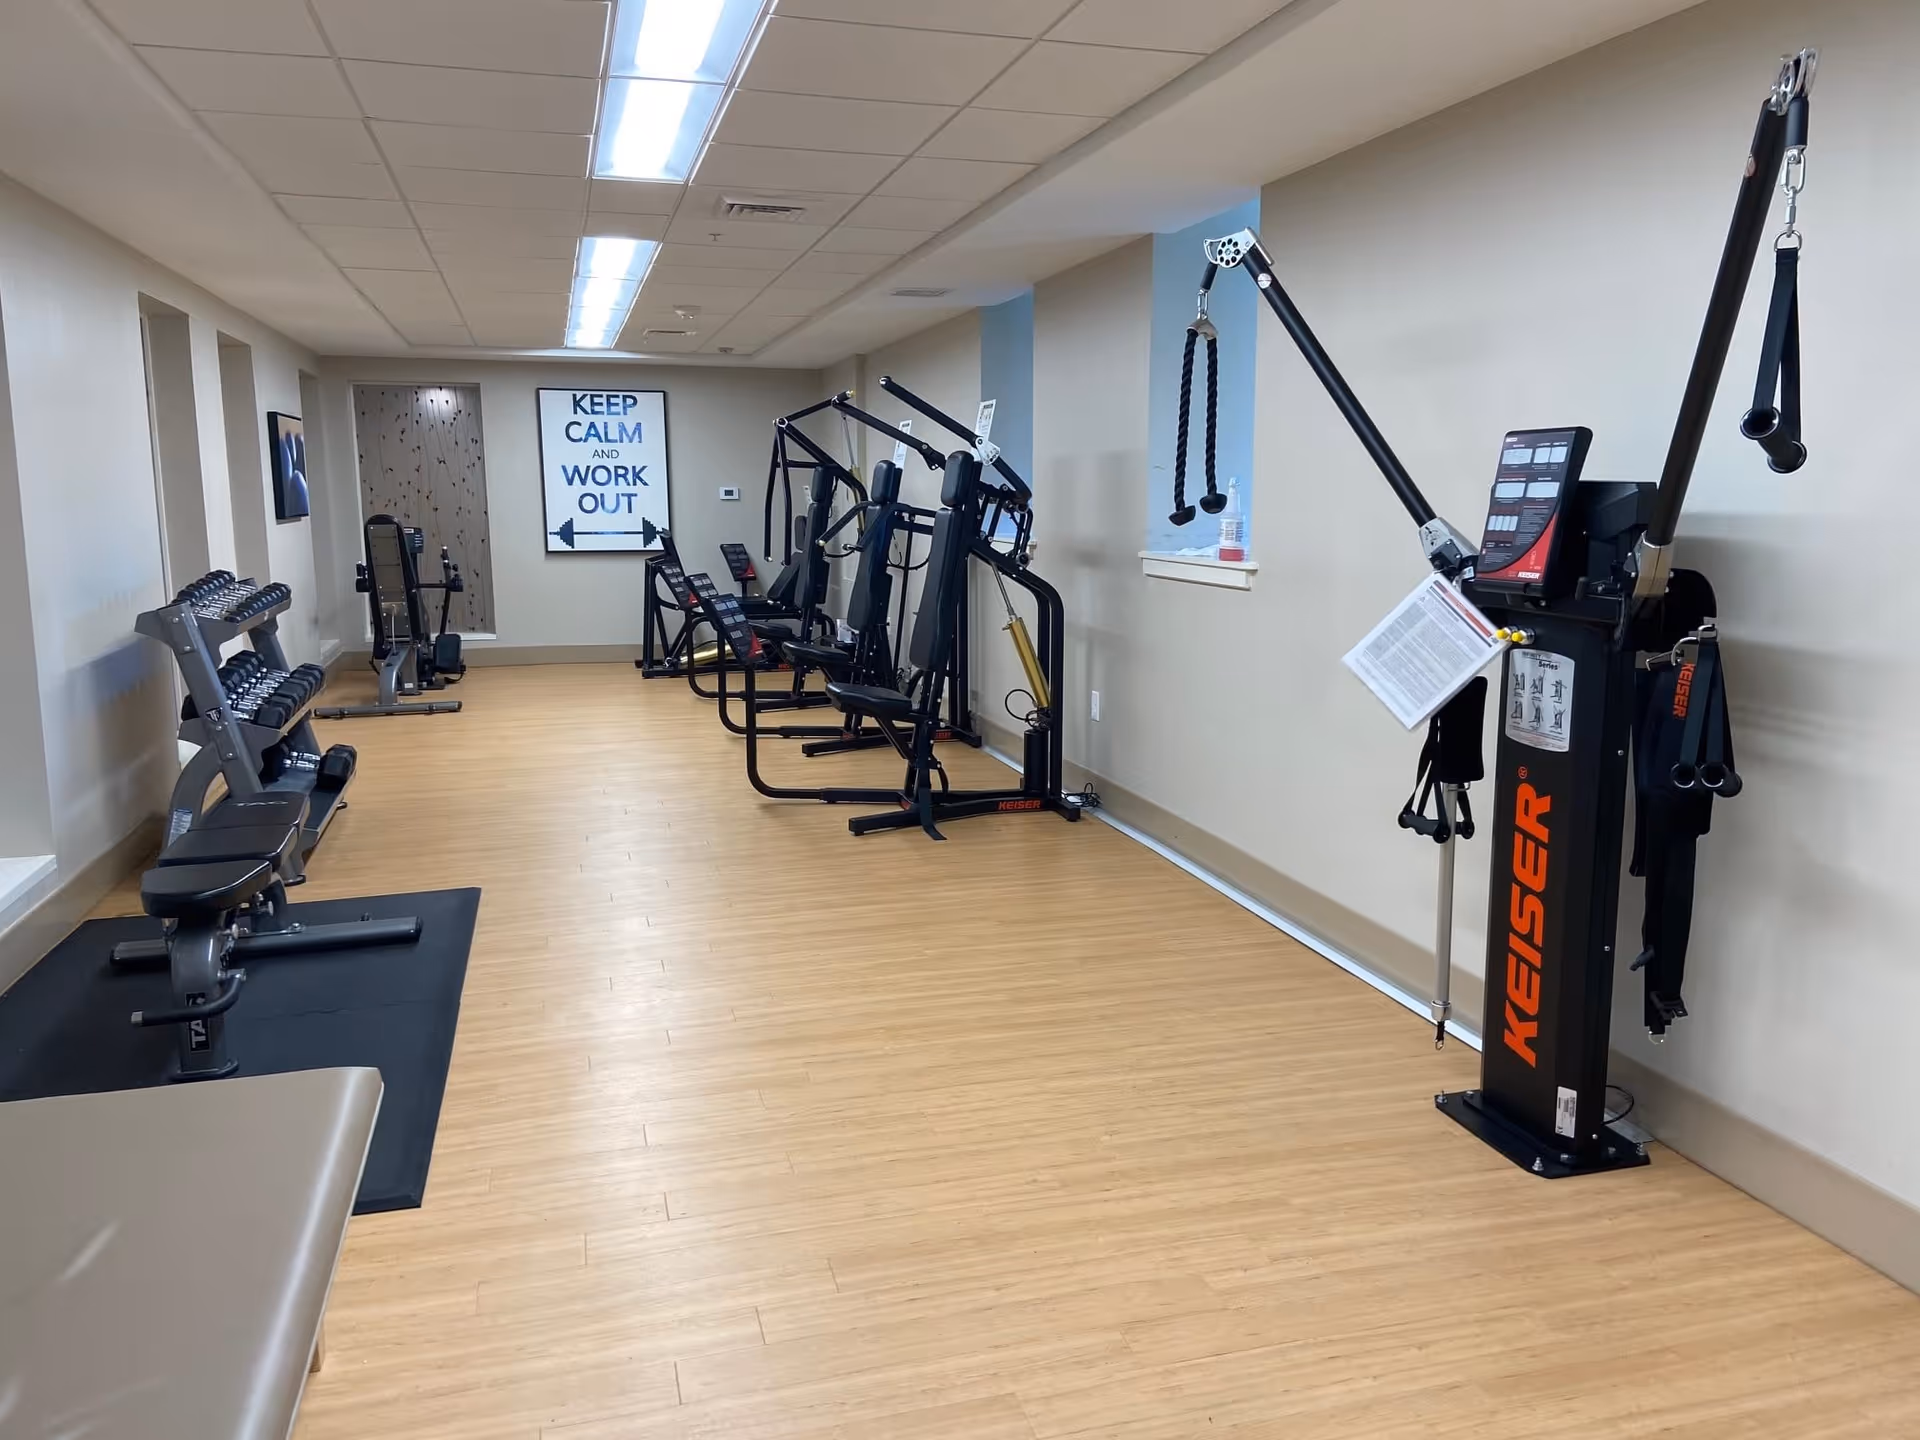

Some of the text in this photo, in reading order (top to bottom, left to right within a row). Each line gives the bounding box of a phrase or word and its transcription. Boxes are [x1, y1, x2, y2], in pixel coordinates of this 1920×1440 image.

[572, 393, 638, 416] KEEP
[565, 421, 643, 443] CALM
[592, 449, 620, 459] AND
[561, 464, 649, 487] WORK
[578, 493, 638, 514] OUT
[1538, 661, 1558, 671] Series
[1673, 663, 1696, 717] KEISER
[998, 800, 1041, 810] KEISER
